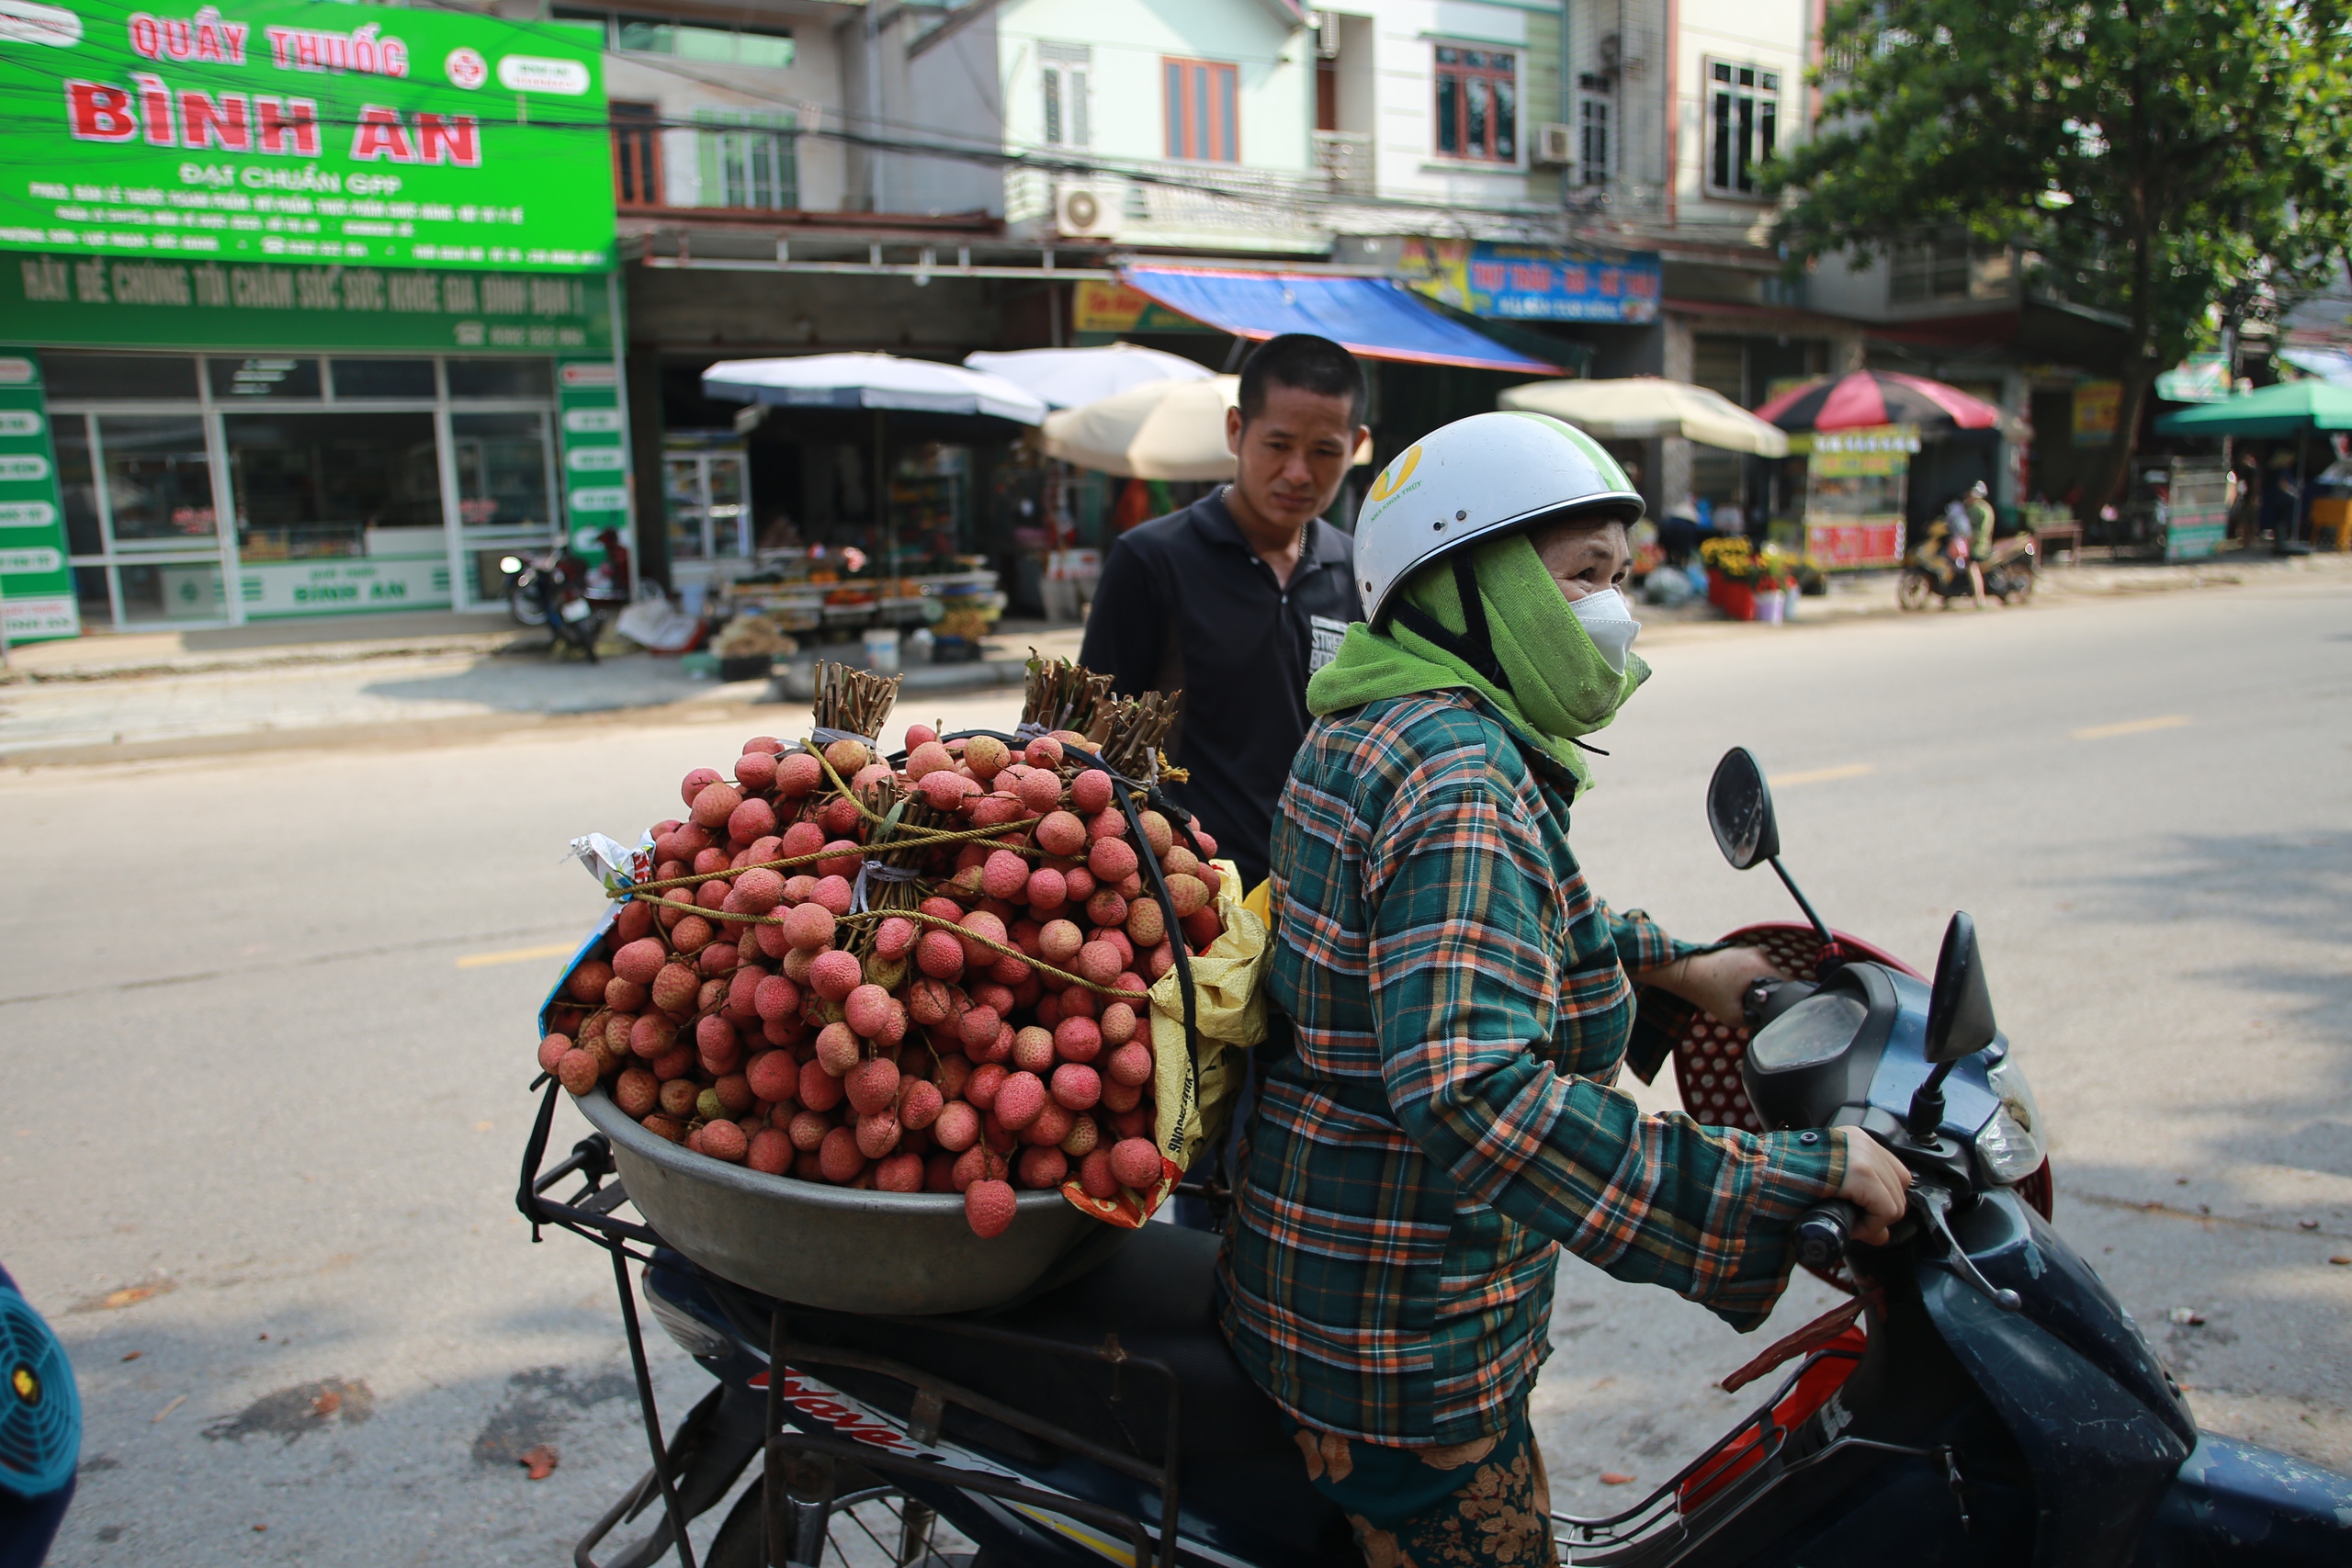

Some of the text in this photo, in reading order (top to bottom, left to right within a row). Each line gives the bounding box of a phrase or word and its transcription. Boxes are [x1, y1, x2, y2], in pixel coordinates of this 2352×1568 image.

[264, 22, 410, 78] THUỐC
[64, 72, 481, 167] BÌNH AN
[178, 162, 402, 196] ĐẠT CHUẨN GPP
[1383, 493, 1400, 511] KHOA
